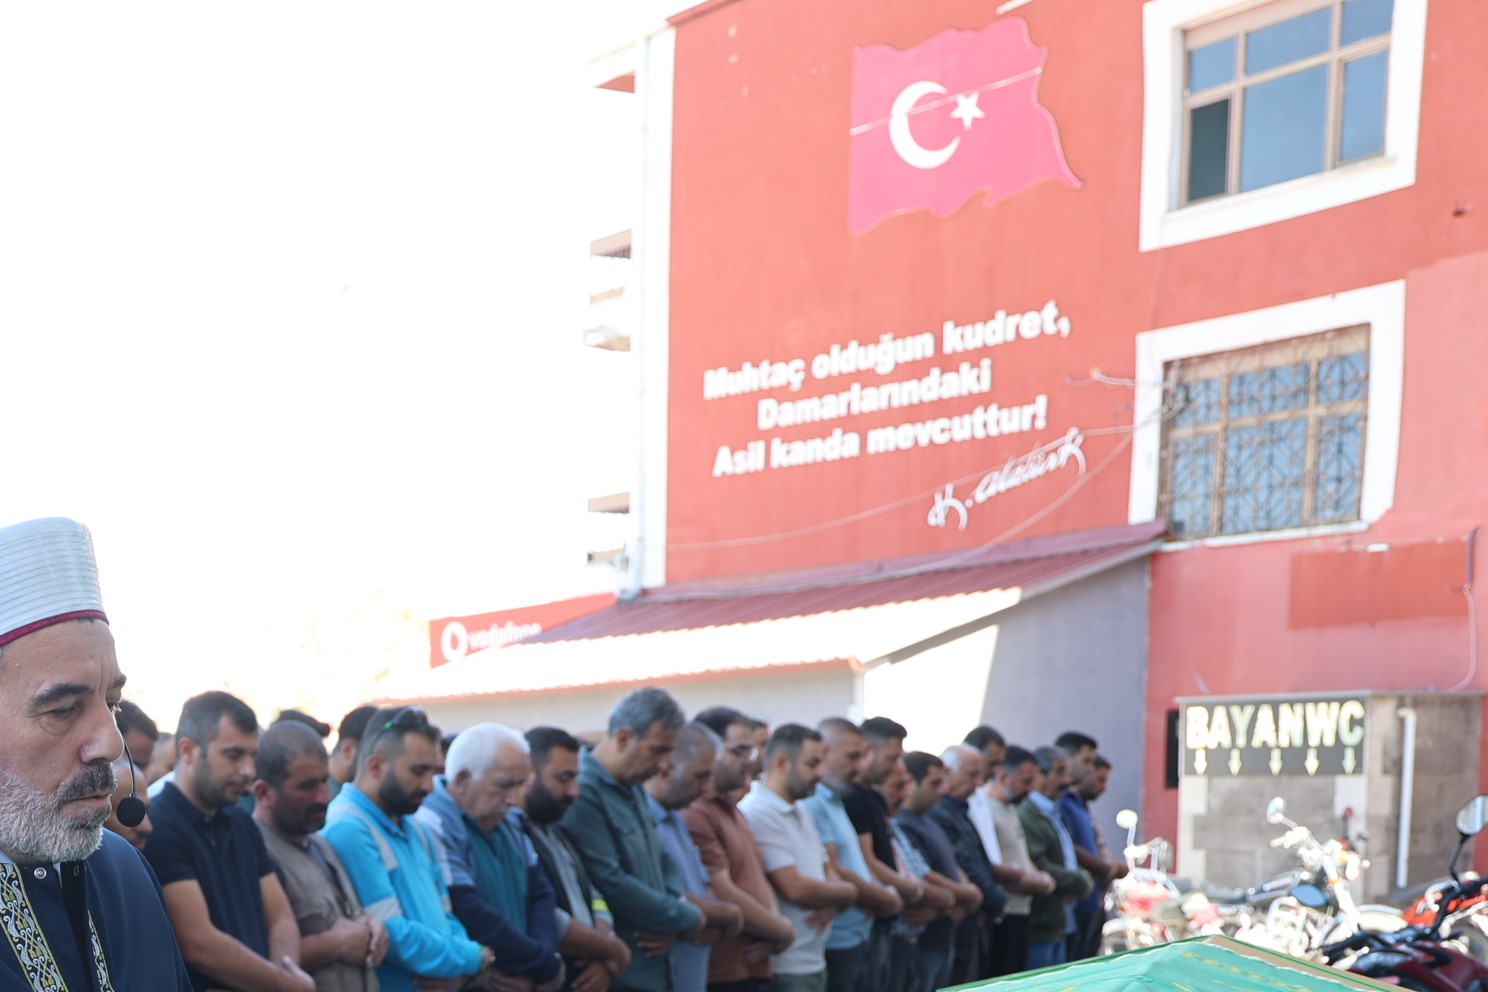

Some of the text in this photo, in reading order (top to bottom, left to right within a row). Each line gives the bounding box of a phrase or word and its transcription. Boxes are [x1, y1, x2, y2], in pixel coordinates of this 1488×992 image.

[703, 299, 1071, 401] Muhtaç olduğun kudret,
[712, 393, 1048, 478] Asil kanda mevcuttur!
[757, 357, 992, 431] Damarlarındaki
